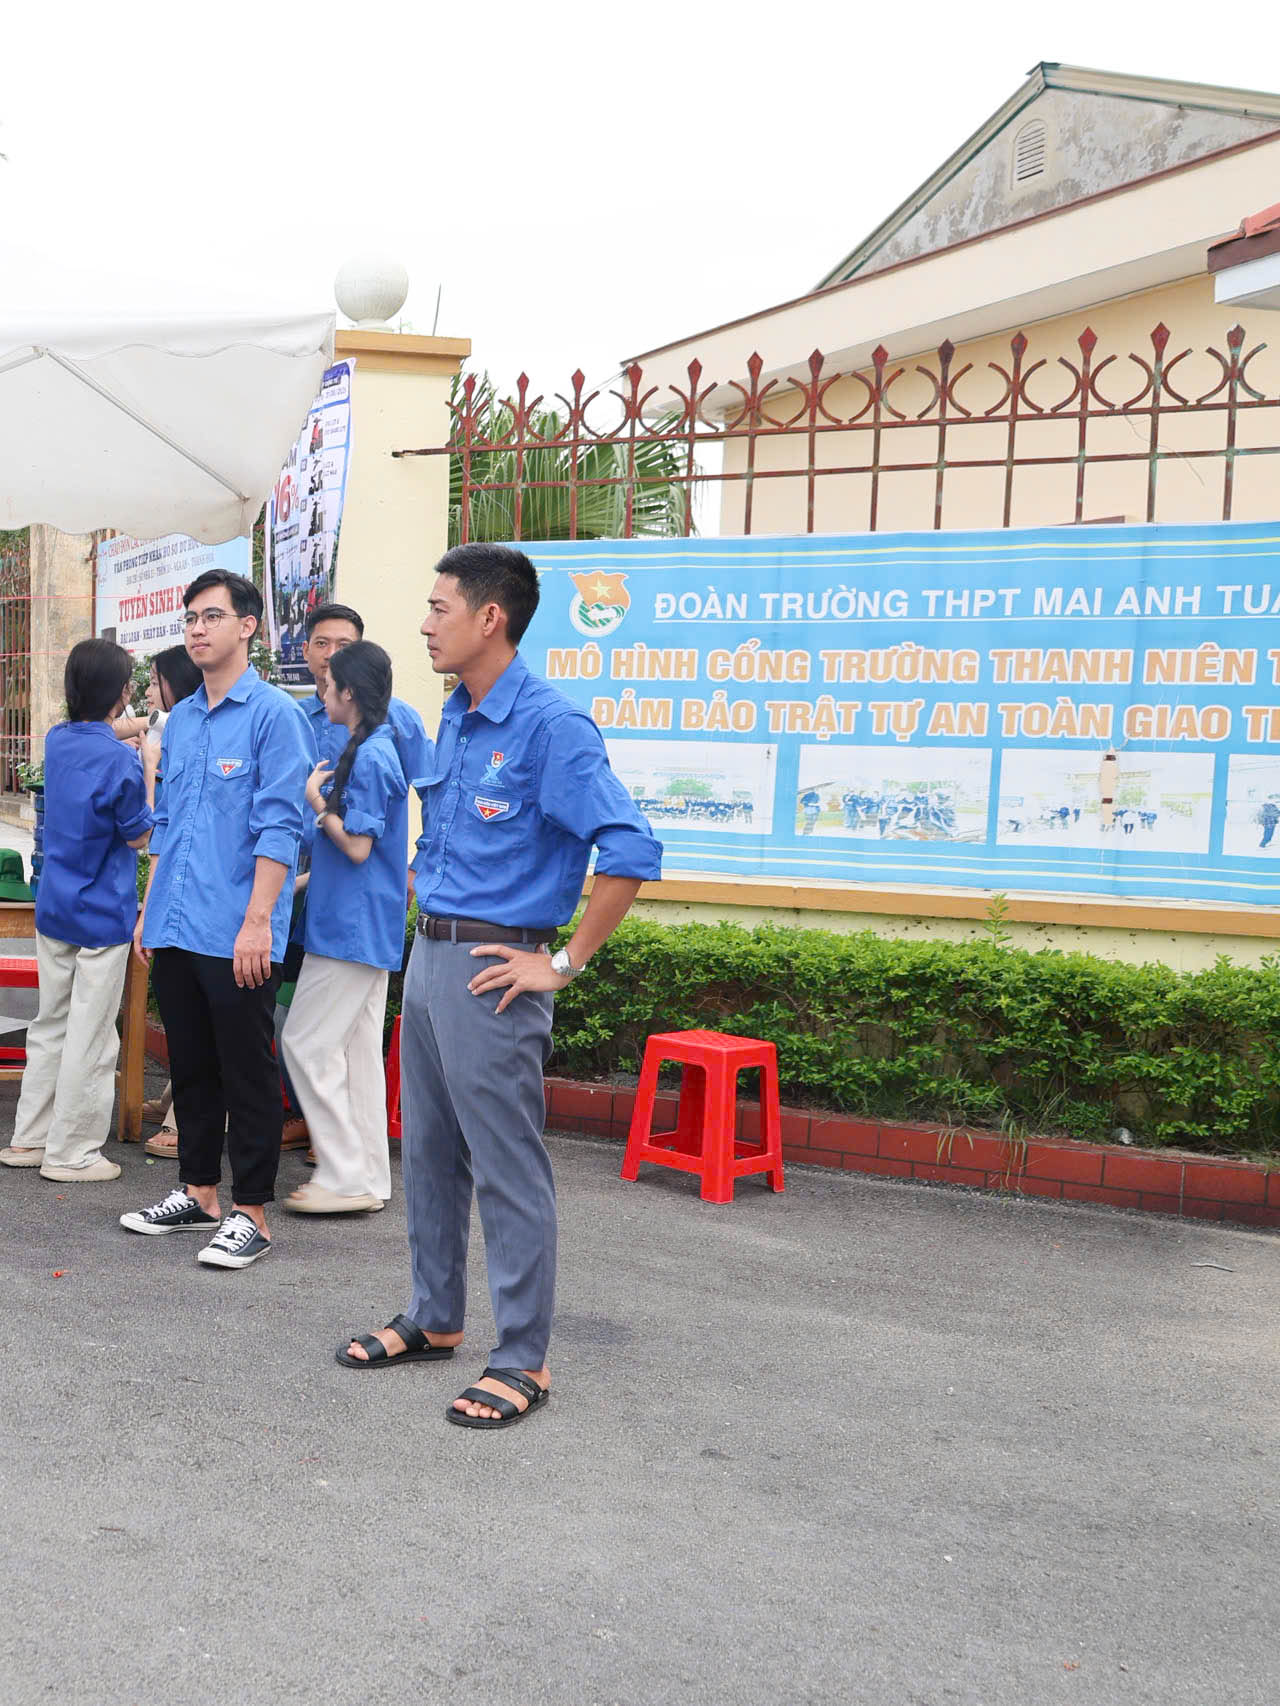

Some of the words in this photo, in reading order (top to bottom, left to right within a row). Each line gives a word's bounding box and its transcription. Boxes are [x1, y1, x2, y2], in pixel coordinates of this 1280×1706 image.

[119, 584, 148, 623] TUYỂN
[149, 586, 173, 618] SINH
[654, 585, 748, 619] ĐOÀN
[759, 584, 909, 619] TRƯỜNG
[922, 587, 1021, 618] THPT
[1033, 587, 1103, 616] MAI
[1114, 585, 1201, 616] ANH
[547, 642, 602, 679] MÔ
[611, 643, 698, 680] HÌNH
[707, 638, 810, 683] CỔNG
[820, 642, 980, 683] TRƯỜNG
[989, 648, 1134, 684] THANH
[1143, 642, 1258, 686] NIÊN
[592, 688, 672, 730] ĐẢM
[681, 690, 756, 731] BẢO
[765, 695, 860, 741] TRẬT
[869, 698, 924, 742] TỰ
[926, 702, 989, 738] AN
[998, 697, 1114, 739] TOÀN
[1124, 705, 1232, 743] GIAO
